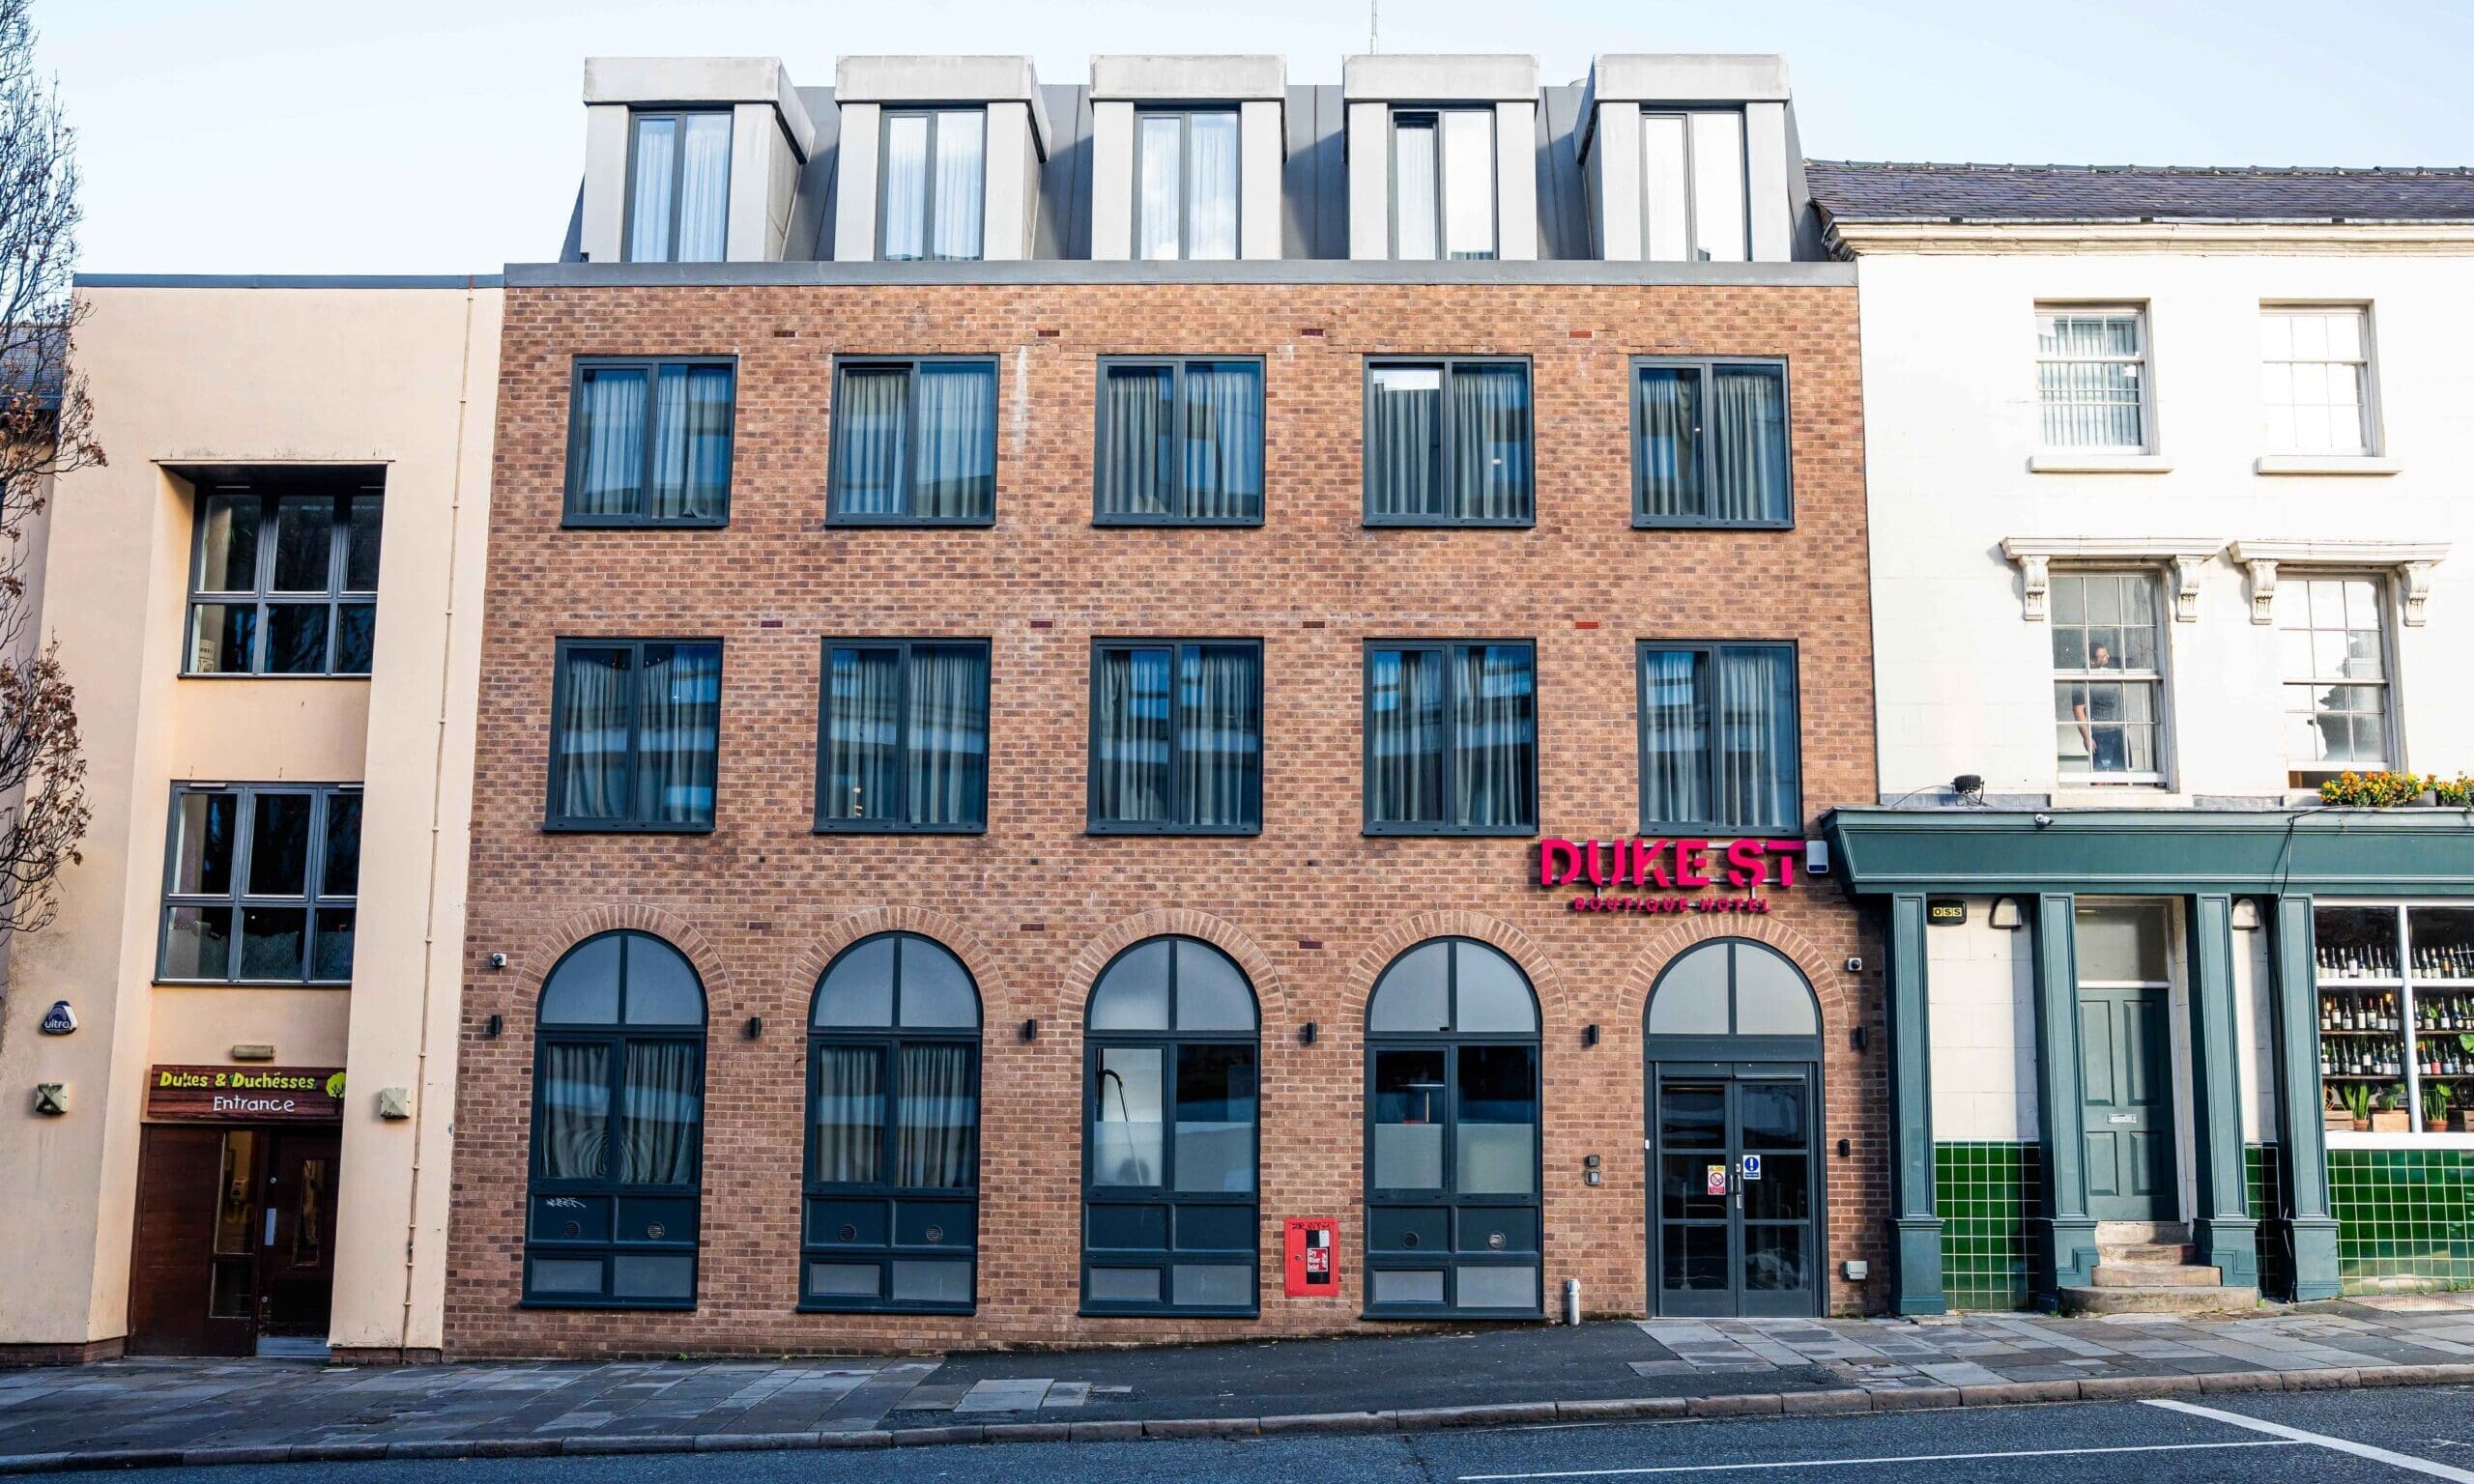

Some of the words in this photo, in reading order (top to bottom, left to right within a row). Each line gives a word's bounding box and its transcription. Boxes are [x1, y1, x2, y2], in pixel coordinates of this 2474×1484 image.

[1540, 839, 1710, 887] DUKE
[1727, 839, 1806, 887] ST
[1574, 897, 1688, 913] BOUTIQUE
[1700, 897, 1772, 913] HOTEL
[44, 1019, 70, 1029] ultra
[159, 1070, 209, 1088] Dukes
[215, 1072, 226, 1087] &
[214, 1095, 295, 1112] Entrance
